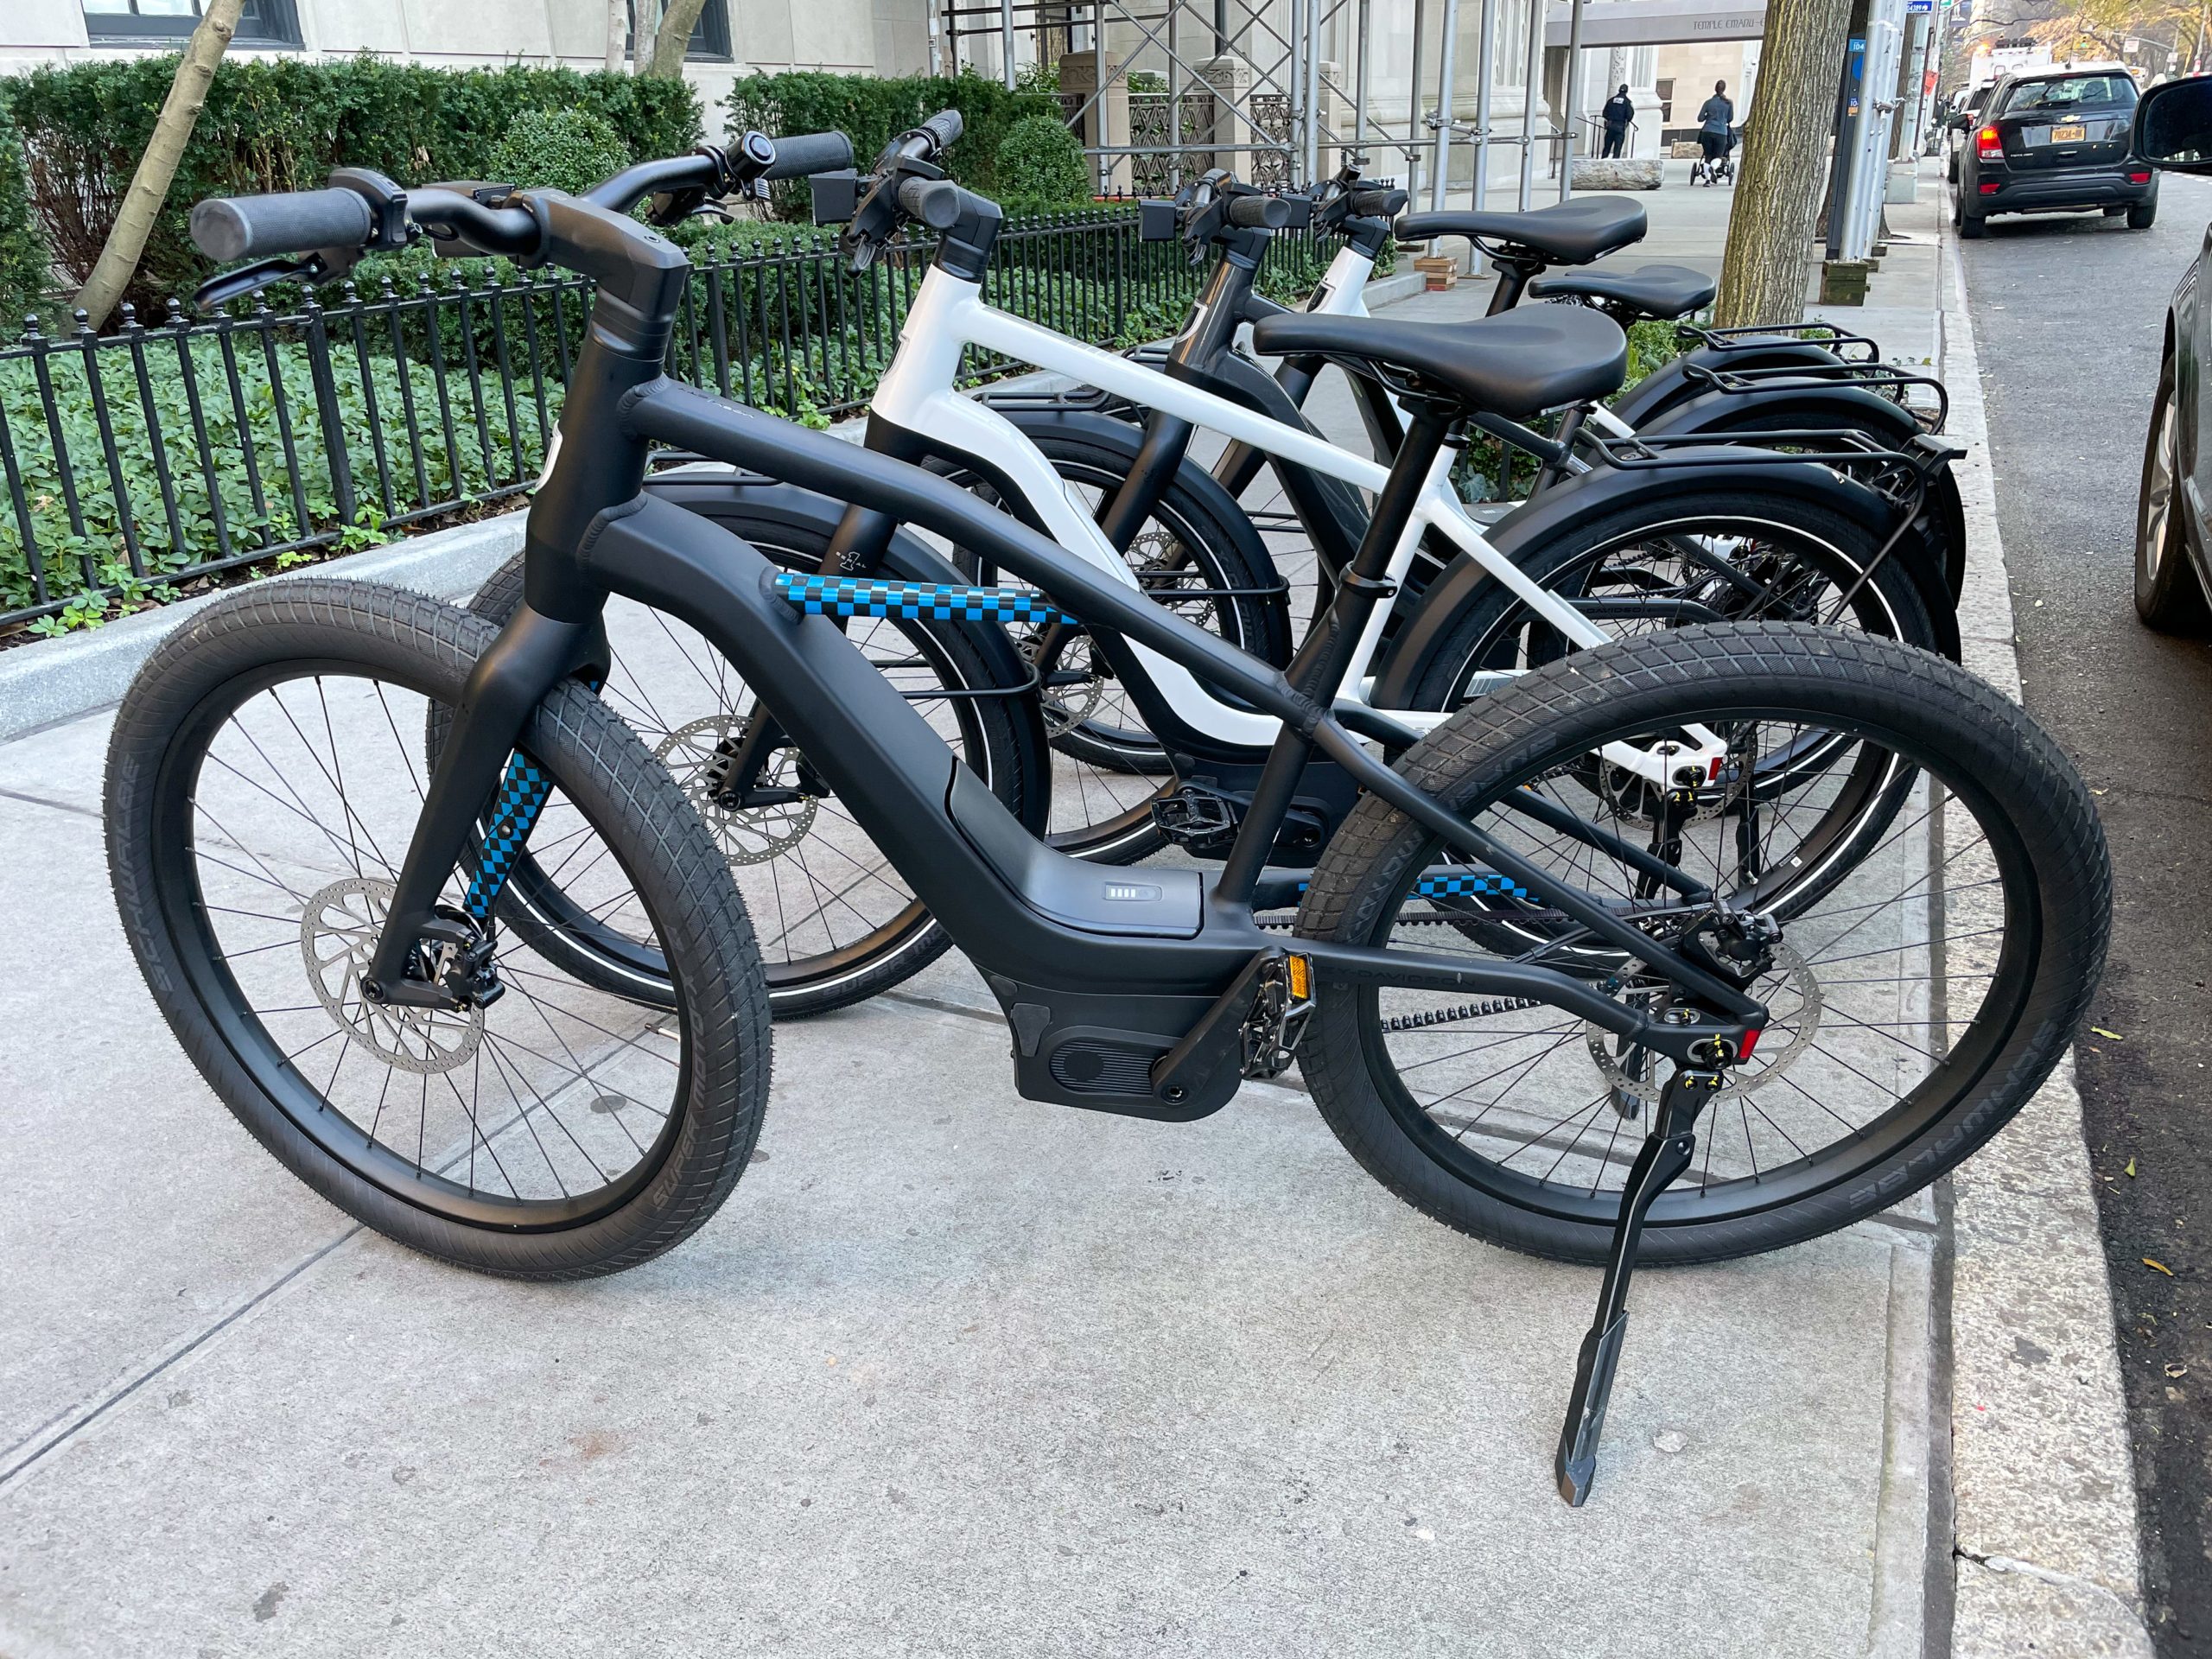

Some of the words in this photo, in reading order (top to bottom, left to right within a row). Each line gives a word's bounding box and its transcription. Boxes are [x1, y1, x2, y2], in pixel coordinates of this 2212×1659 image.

[1694, 19, 1722, 30] TEMPLE
[114, 752, 175, 994] SCHWALBE
[652, 1112, 702, 1212] SUPER
[680, 973, 707, 1110] MOTO-X
